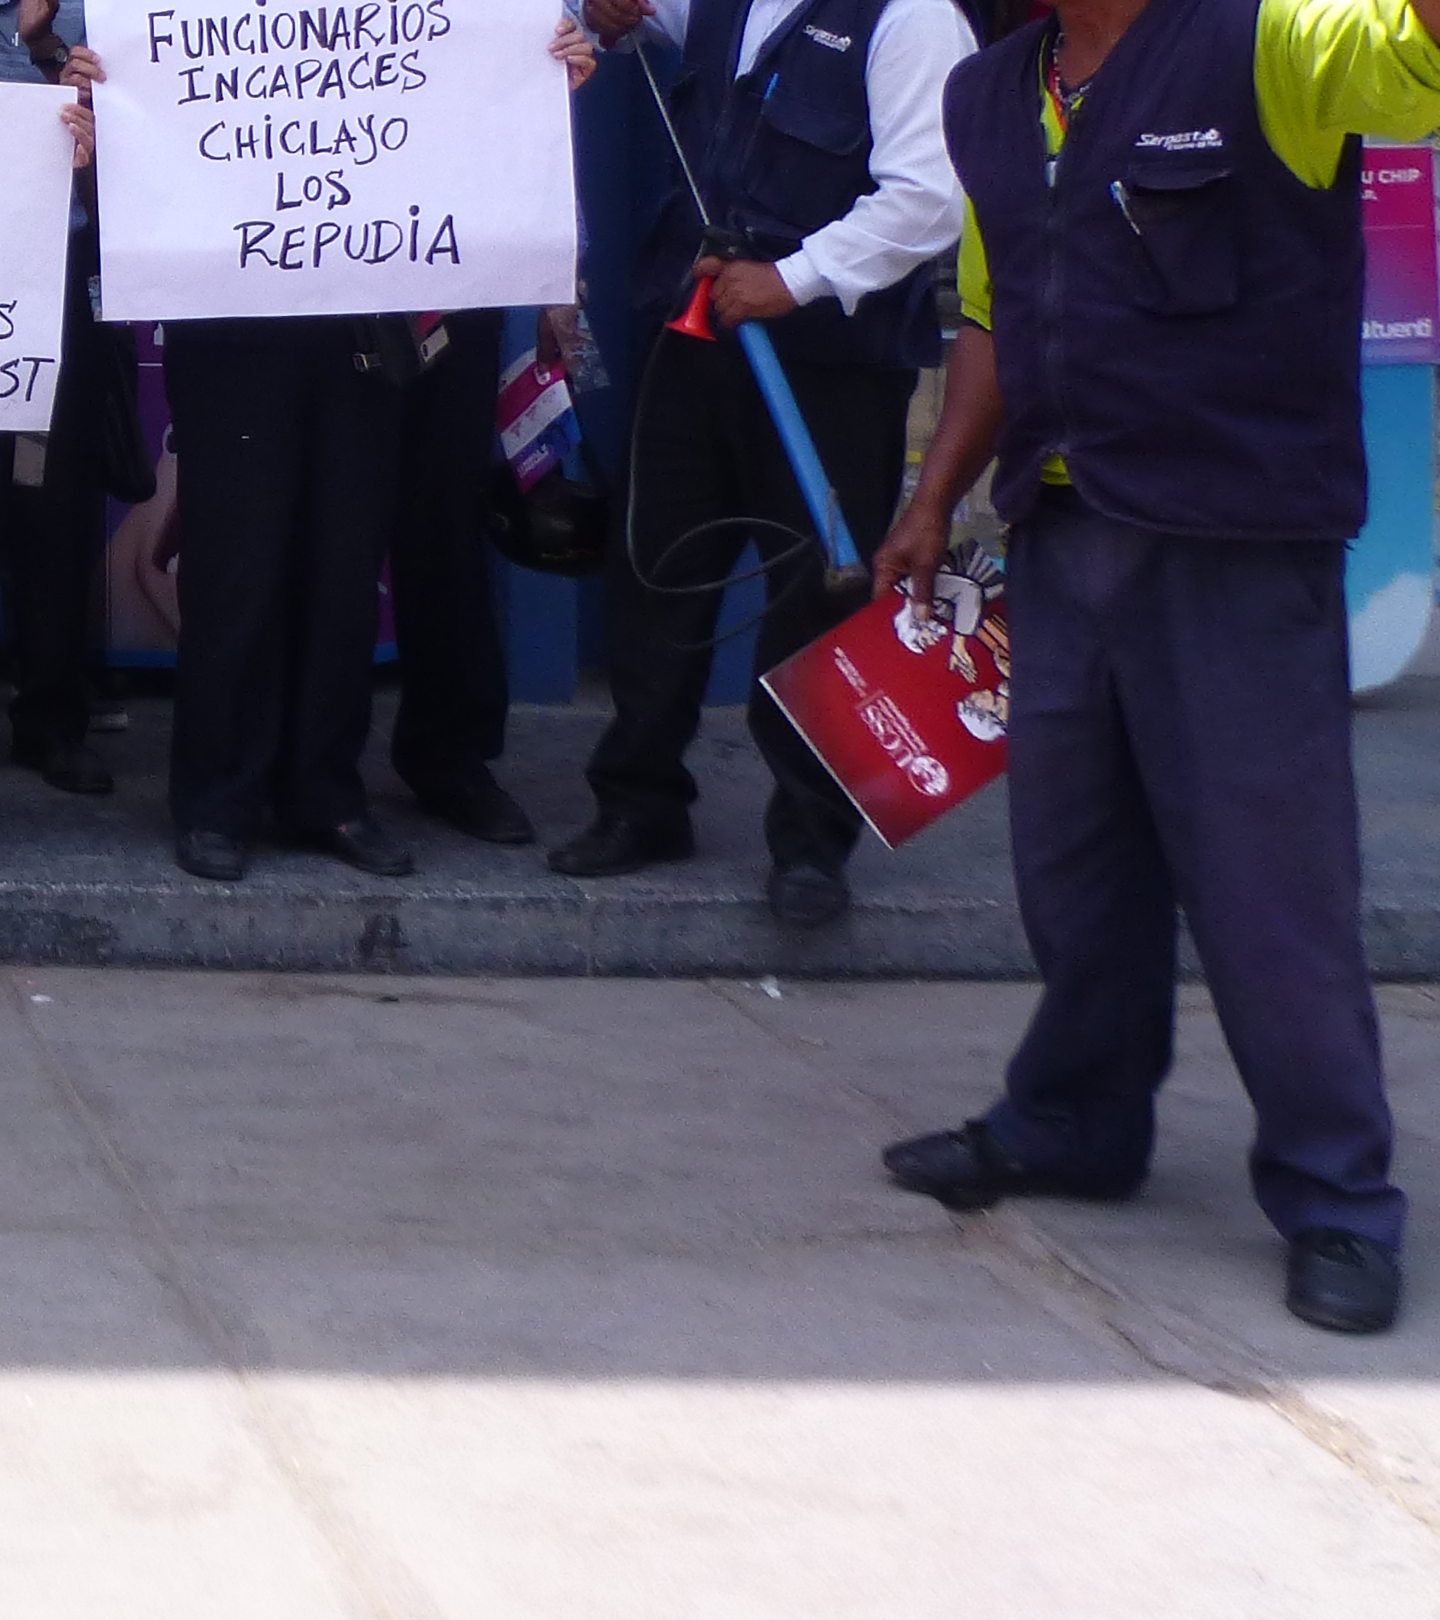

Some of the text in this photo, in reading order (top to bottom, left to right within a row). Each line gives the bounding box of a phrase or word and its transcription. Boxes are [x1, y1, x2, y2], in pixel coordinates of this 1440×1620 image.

[177, 49, 427, 106] INCAPACES
[198, 114, 409, 165] CHICLAYO
[276, 168, 352, 211] LOS
[1378, 168, 1421, 184] CHIP
[232, 204, 462, 270] REPUDIA
